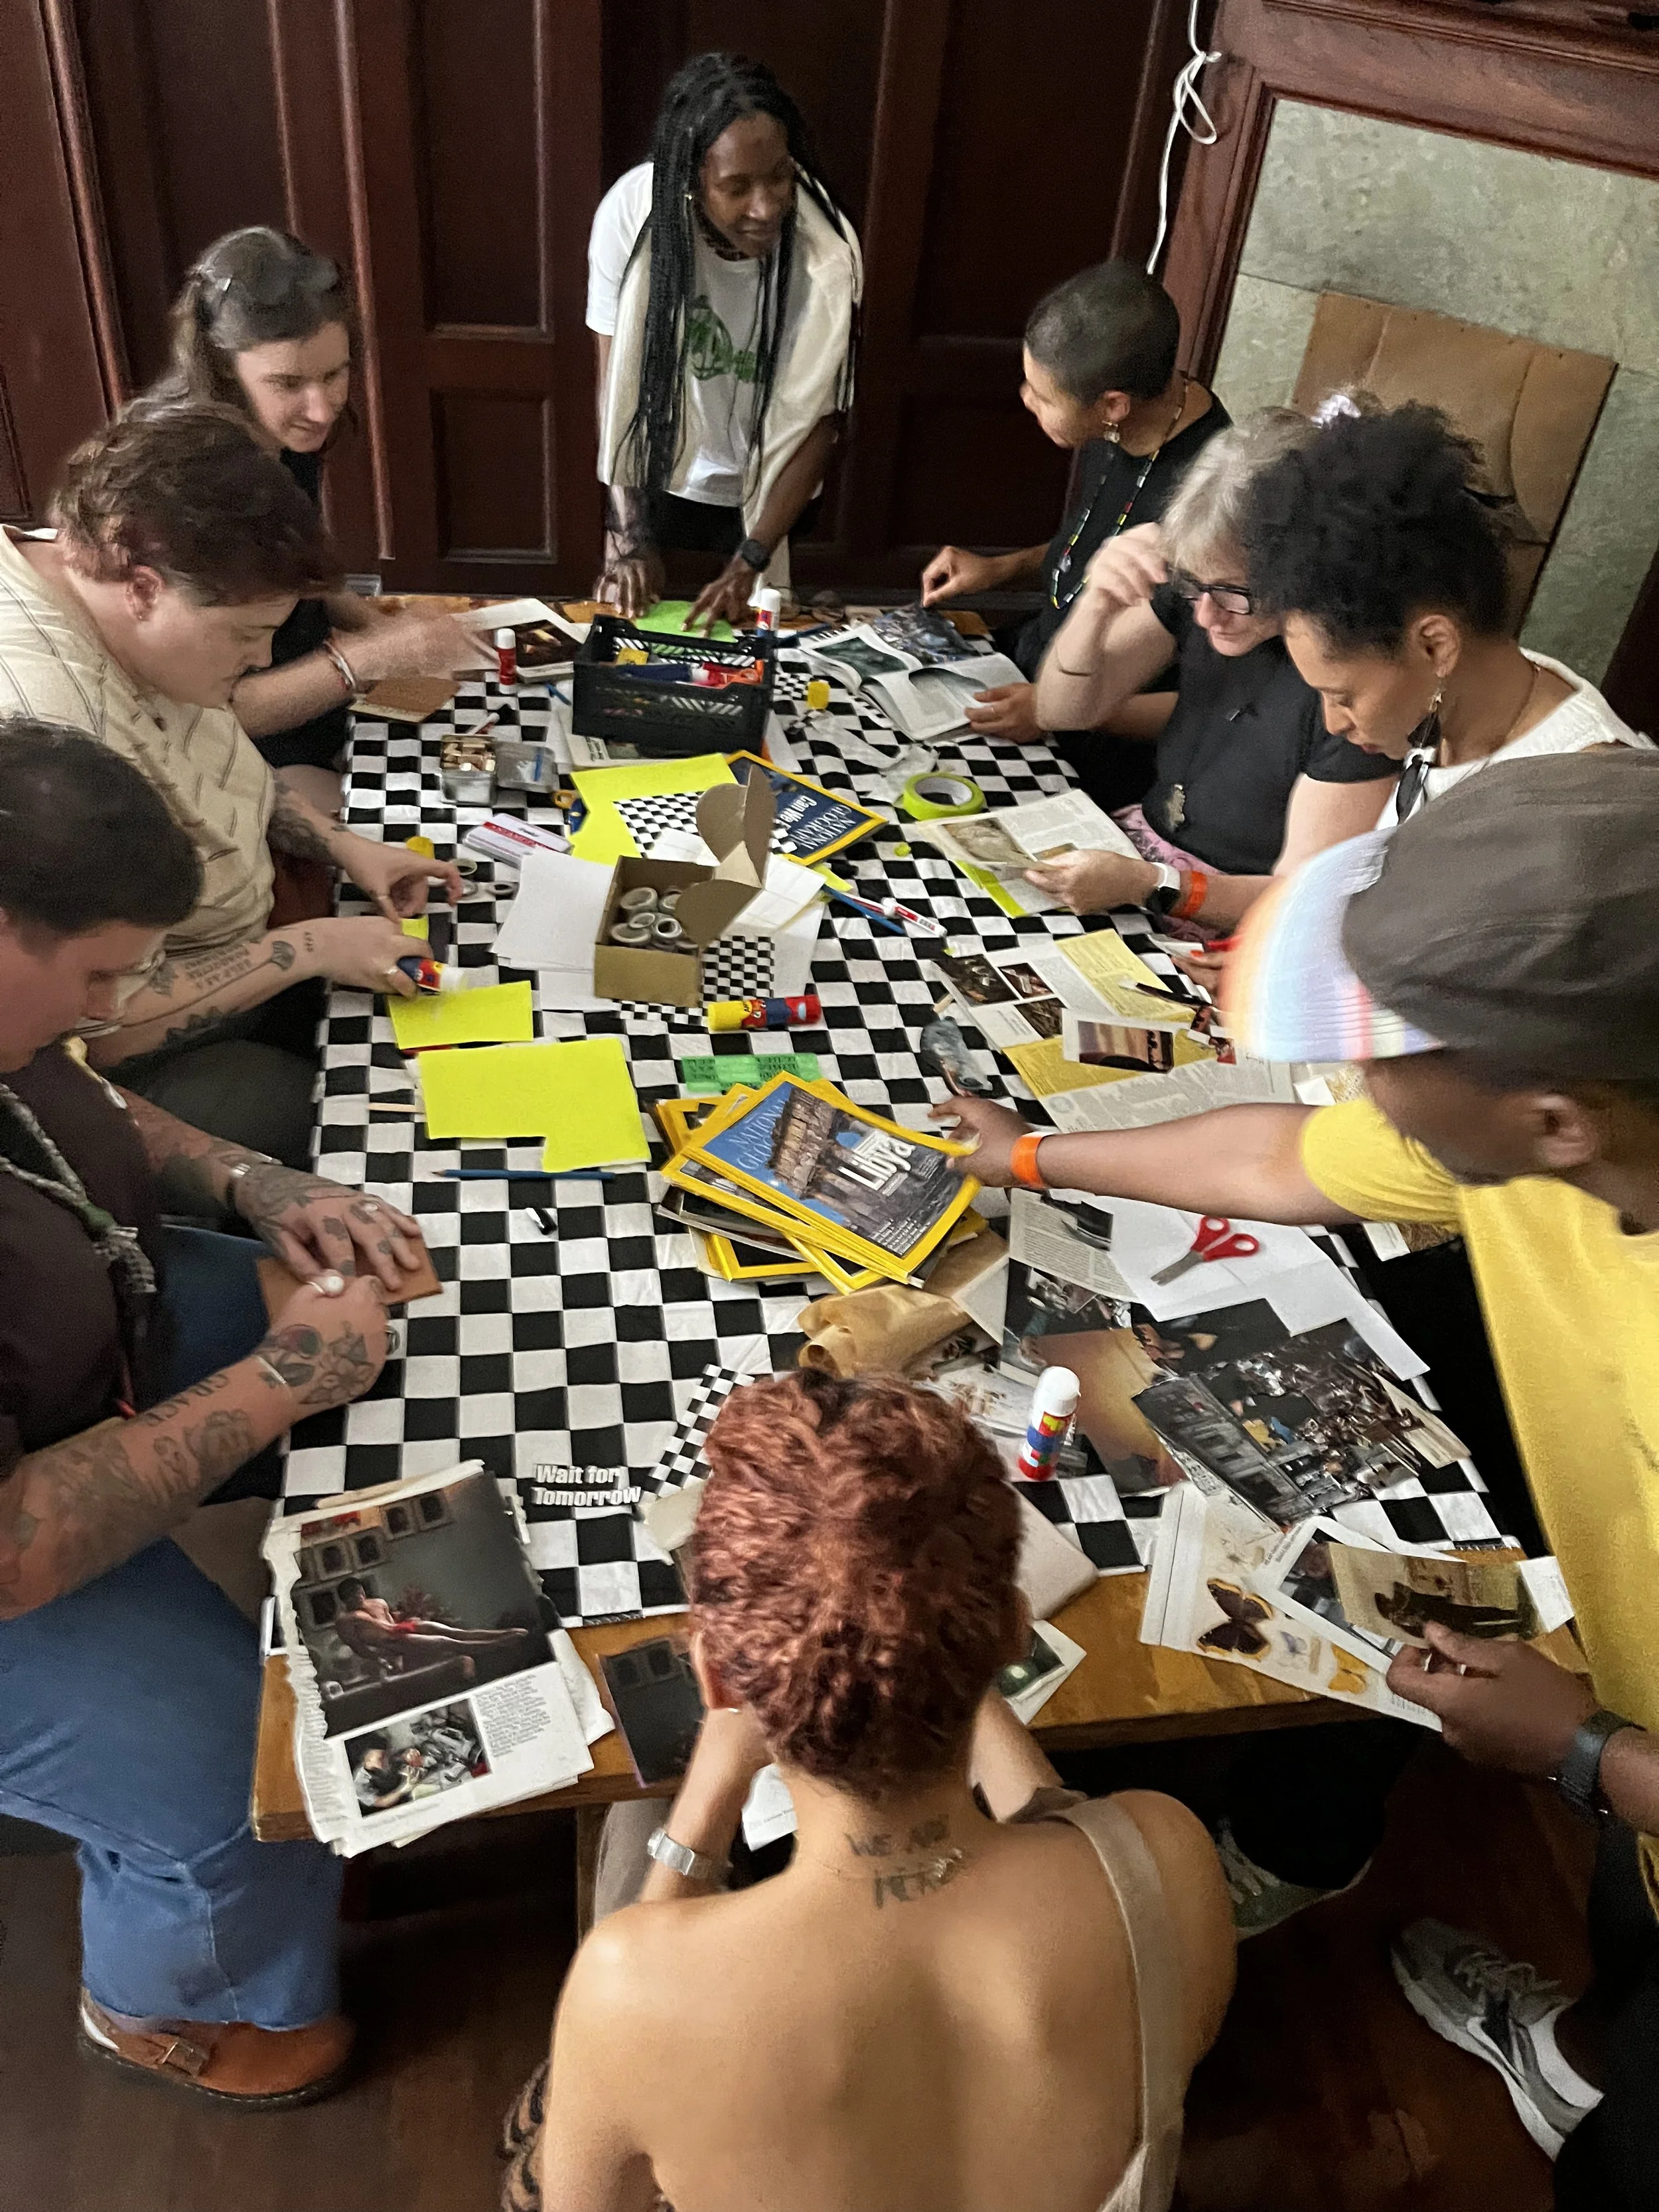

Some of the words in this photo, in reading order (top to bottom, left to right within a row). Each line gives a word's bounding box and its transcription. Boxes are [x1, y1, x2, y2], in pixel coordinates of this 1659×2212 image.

[790, 795, 818, 812] Can
[780, 808, 804, 823] We
[837, 1136, 916, 1191] Libya
[536, 1464, 584, 1485] Wait
[586, 1465, 621, 1484] for
[532, 1486, 642, 1507] Tomorrow
